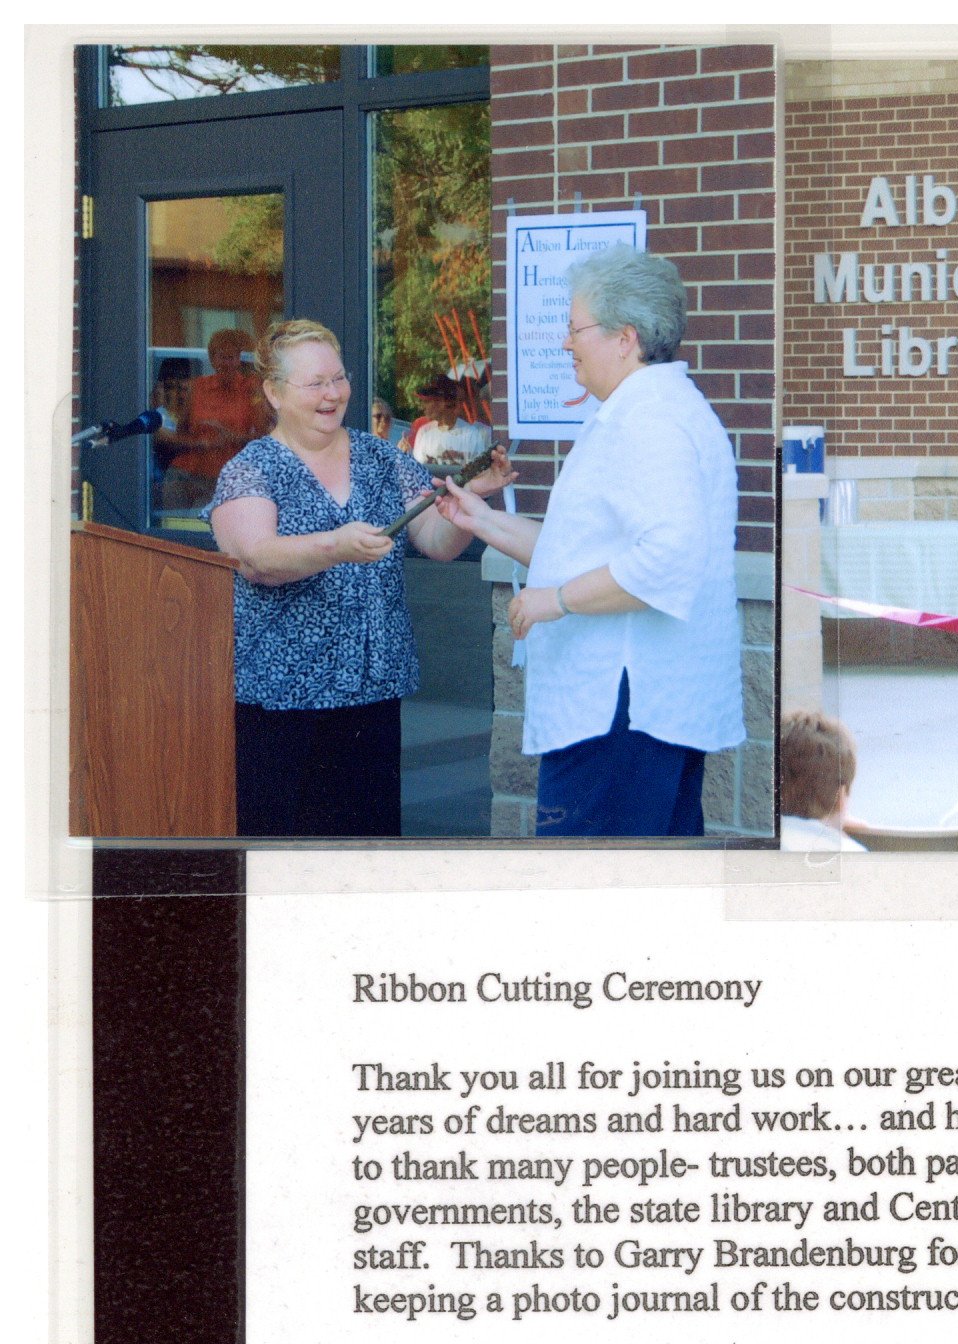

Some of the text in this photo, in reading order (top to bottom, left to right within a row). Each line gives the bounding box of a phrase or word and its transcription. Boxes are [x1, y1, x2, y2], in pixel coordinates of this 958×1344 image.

[521, 231, 560, 252] Albion
[565, 229, 610, 250] Library
[523, 265, 568, 288] Heritag
[521, 384, 560, 397] Monday
[522, 398, 542, 412] July
[353, 972, 762, 1009] Ribbon Cutting Ceremony
[352, 1063, 451, 1091] Thank
[460, 1071, 518, 1098] you
[529, 1062, 566, 1089] all
[578, 1061, 623, 1089] for
[628, 1061, 742, 1097] joining
[751, 1069, 785, 1088] us
[796, 1068, 834, 1087] on
[844, 1068, 896, 1087] our
[354, 1200, 561, 1233] governments,
[572, 1194, 619, 1223] the
[631, 1198, 700, 1223] state
[711, 1193, 813, 1229] library
[824, 1192, 880, 1221] and
[354, 1241, 429, 1269] staff.
[451, 1240, 564, 1268] Thanks
[574, 1244, 604, 1268] to
[615, 1240, 704, 1275] Garry
[714, 1238, 917, 1274] Brandenburg
